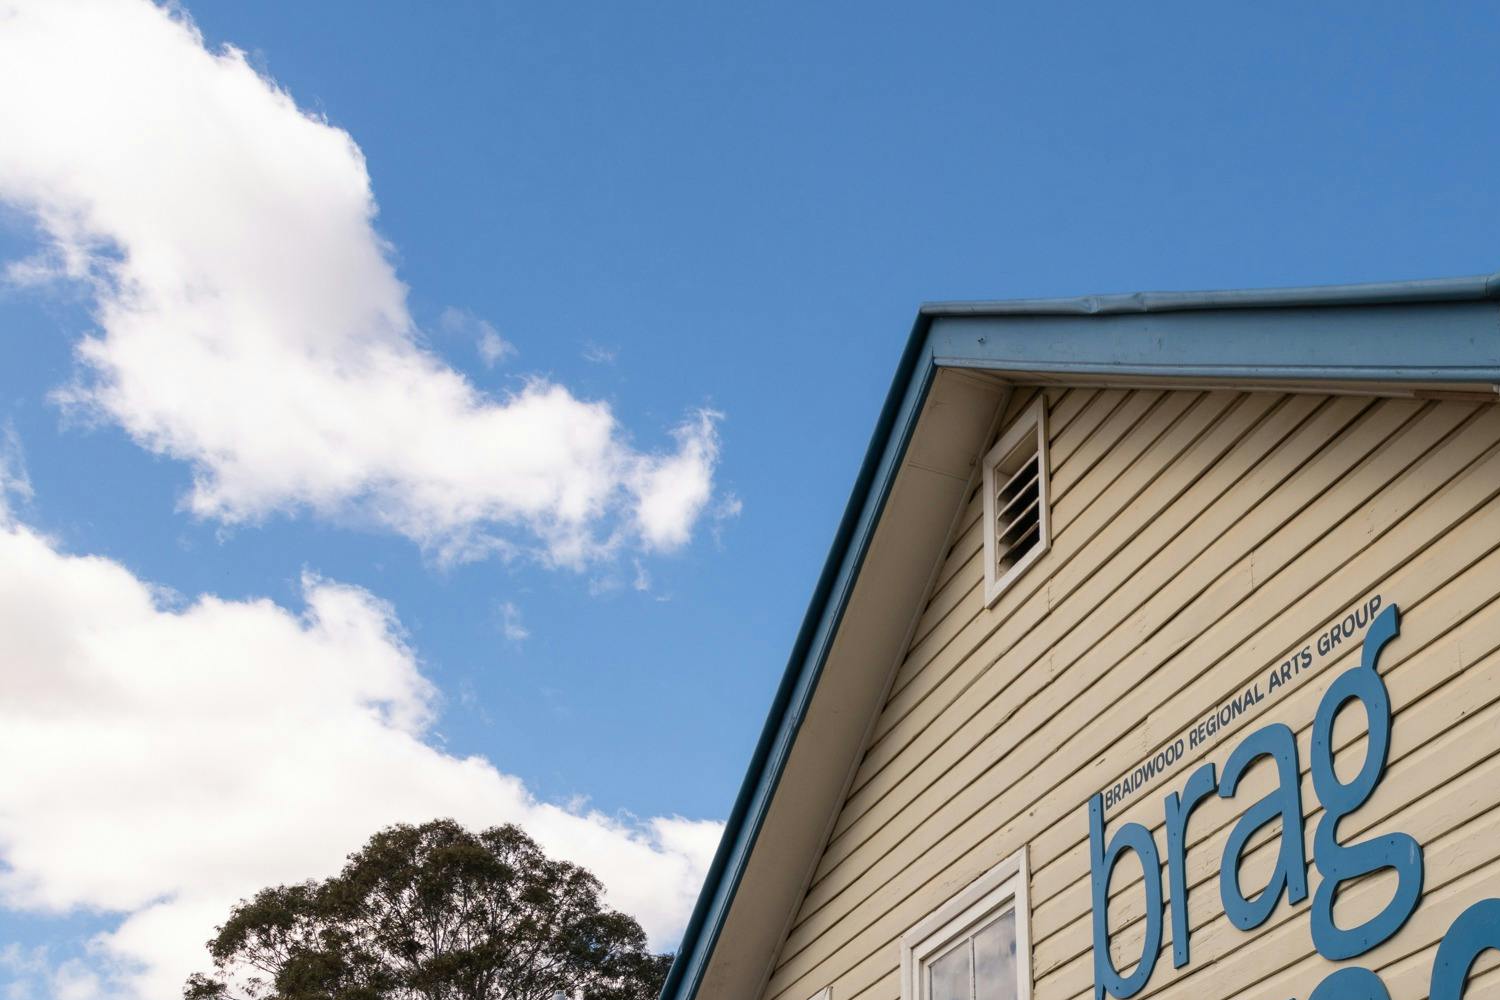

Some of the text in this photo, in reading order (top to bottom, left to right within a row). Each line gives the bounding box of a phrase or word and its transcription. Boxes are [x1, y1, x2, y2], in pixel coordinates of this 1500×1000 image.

[1105, 595, 1383, 811] BRAIDWOOD REGIONAL ARTS GROUP
